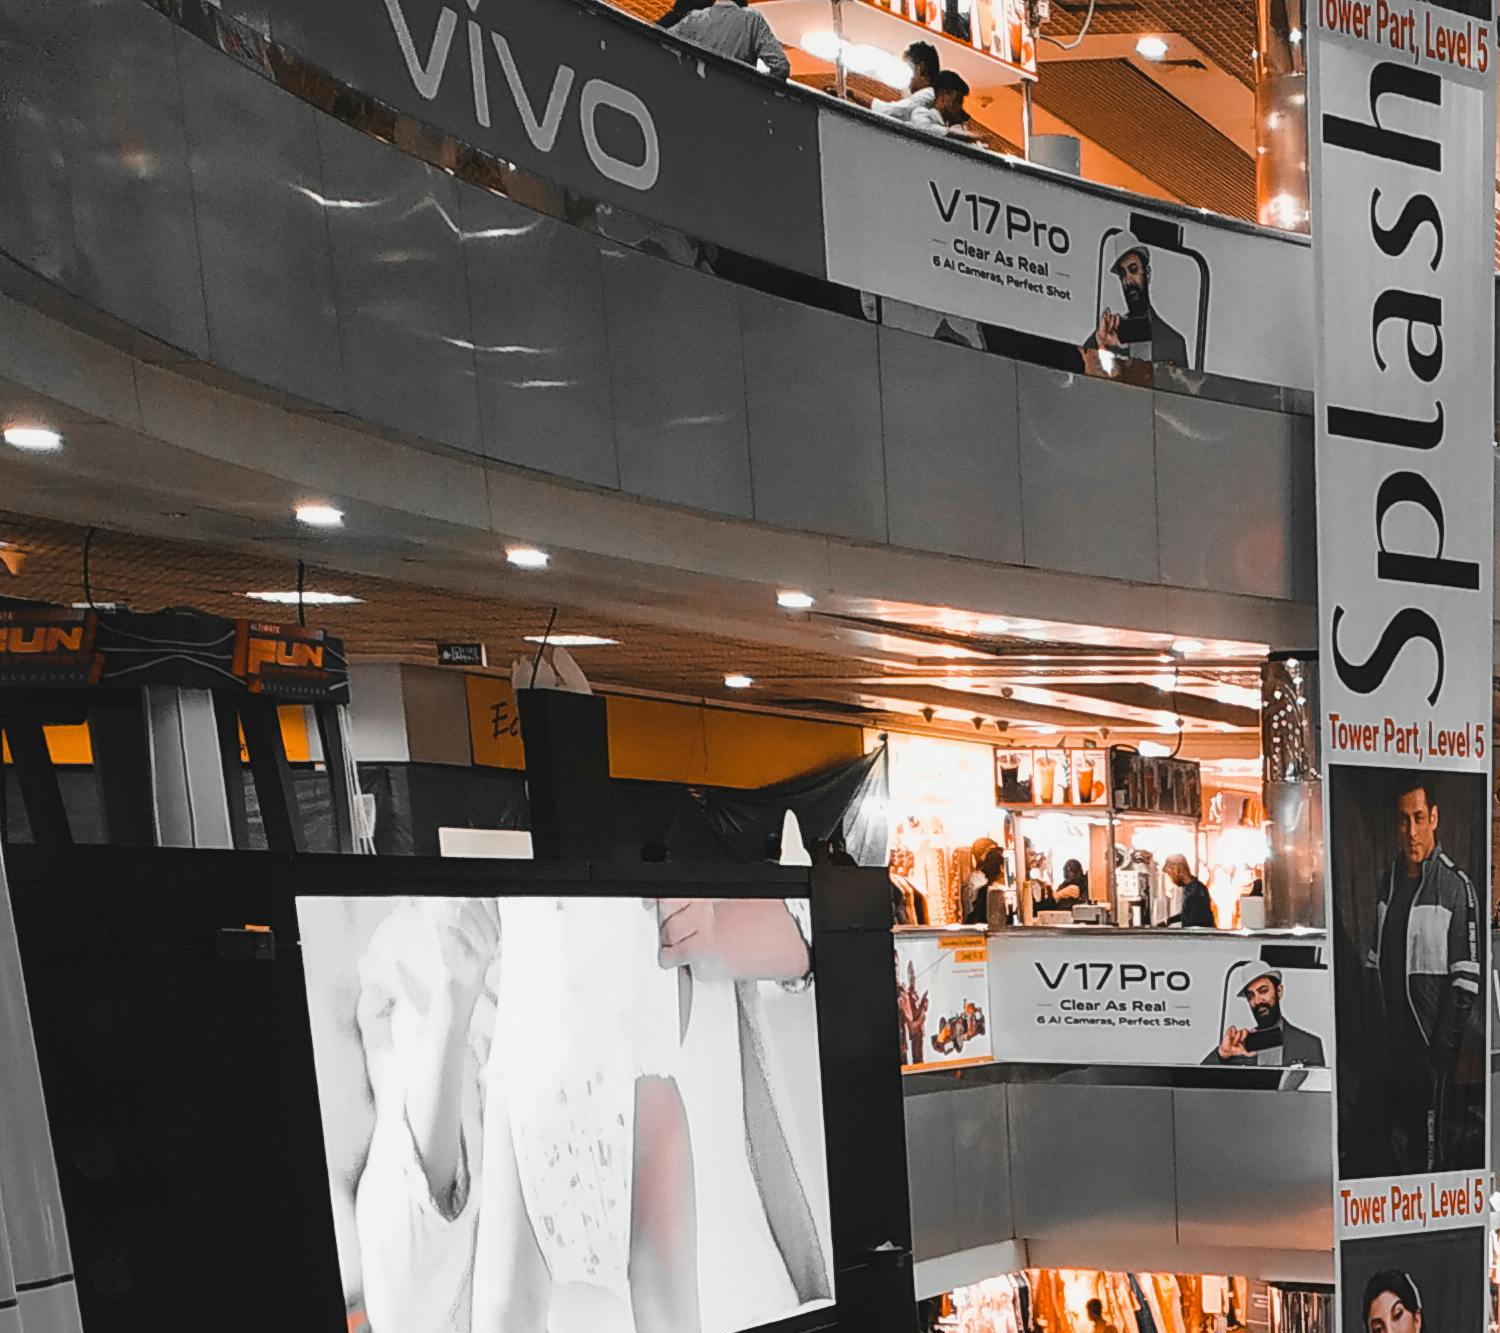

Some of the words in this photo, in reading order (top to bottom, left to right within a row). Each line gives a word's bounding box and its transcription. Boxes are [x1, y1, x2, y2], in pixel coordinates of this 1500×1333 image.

[1319, 0, 1371, 39] Tower
[1376, 0, 1419, 65] Part,
[1426, 11, 1471, 69] Level
[1477, 27, 1488, 73] 5
[932, 255, 941, 267] 6
[943, 259, 956, 271] AI
[957, 262, 1004, 286] Cameras,
[1006, 275, 1044, 294] Perfect
[1046, 285, 1071, 300] Shot
[953, 238, 990, 261] Clear
[994, 249, 1014, 268] As
[1018, 255, 1049, 276] Real
[1322, 61, 1480, 707] Splash
[249, 637, 324, 675] FUN
[1328, 713, 1379, 752] Tower
[1384, 718, 1423, 762] Part,
[1428, 721, 1470, 758] Level
[1474, 724, 1484, 759] 5
[1036, 1015, 1046, 1025] 6
[1048, 1015, 1062, 1025] AI
[1064, 1016, 1116, 1027] Cameras,
[1118, 1016, 1161, 1026] Perfect
[1163, 1017, 1191, 1027] Shot
[1060, 998, 1100, 1012] Clear
[1106, 999, 1128, 1012] As
[1132, 1000, 1167, 1013] Real
[1341, 1187, 1387, 1227] Tower
[1391, 1185, 1427, 1228] Part,
[1431, 1176, 1470, 1216] Level
[1473, 1178, 1483, 1214] 5
